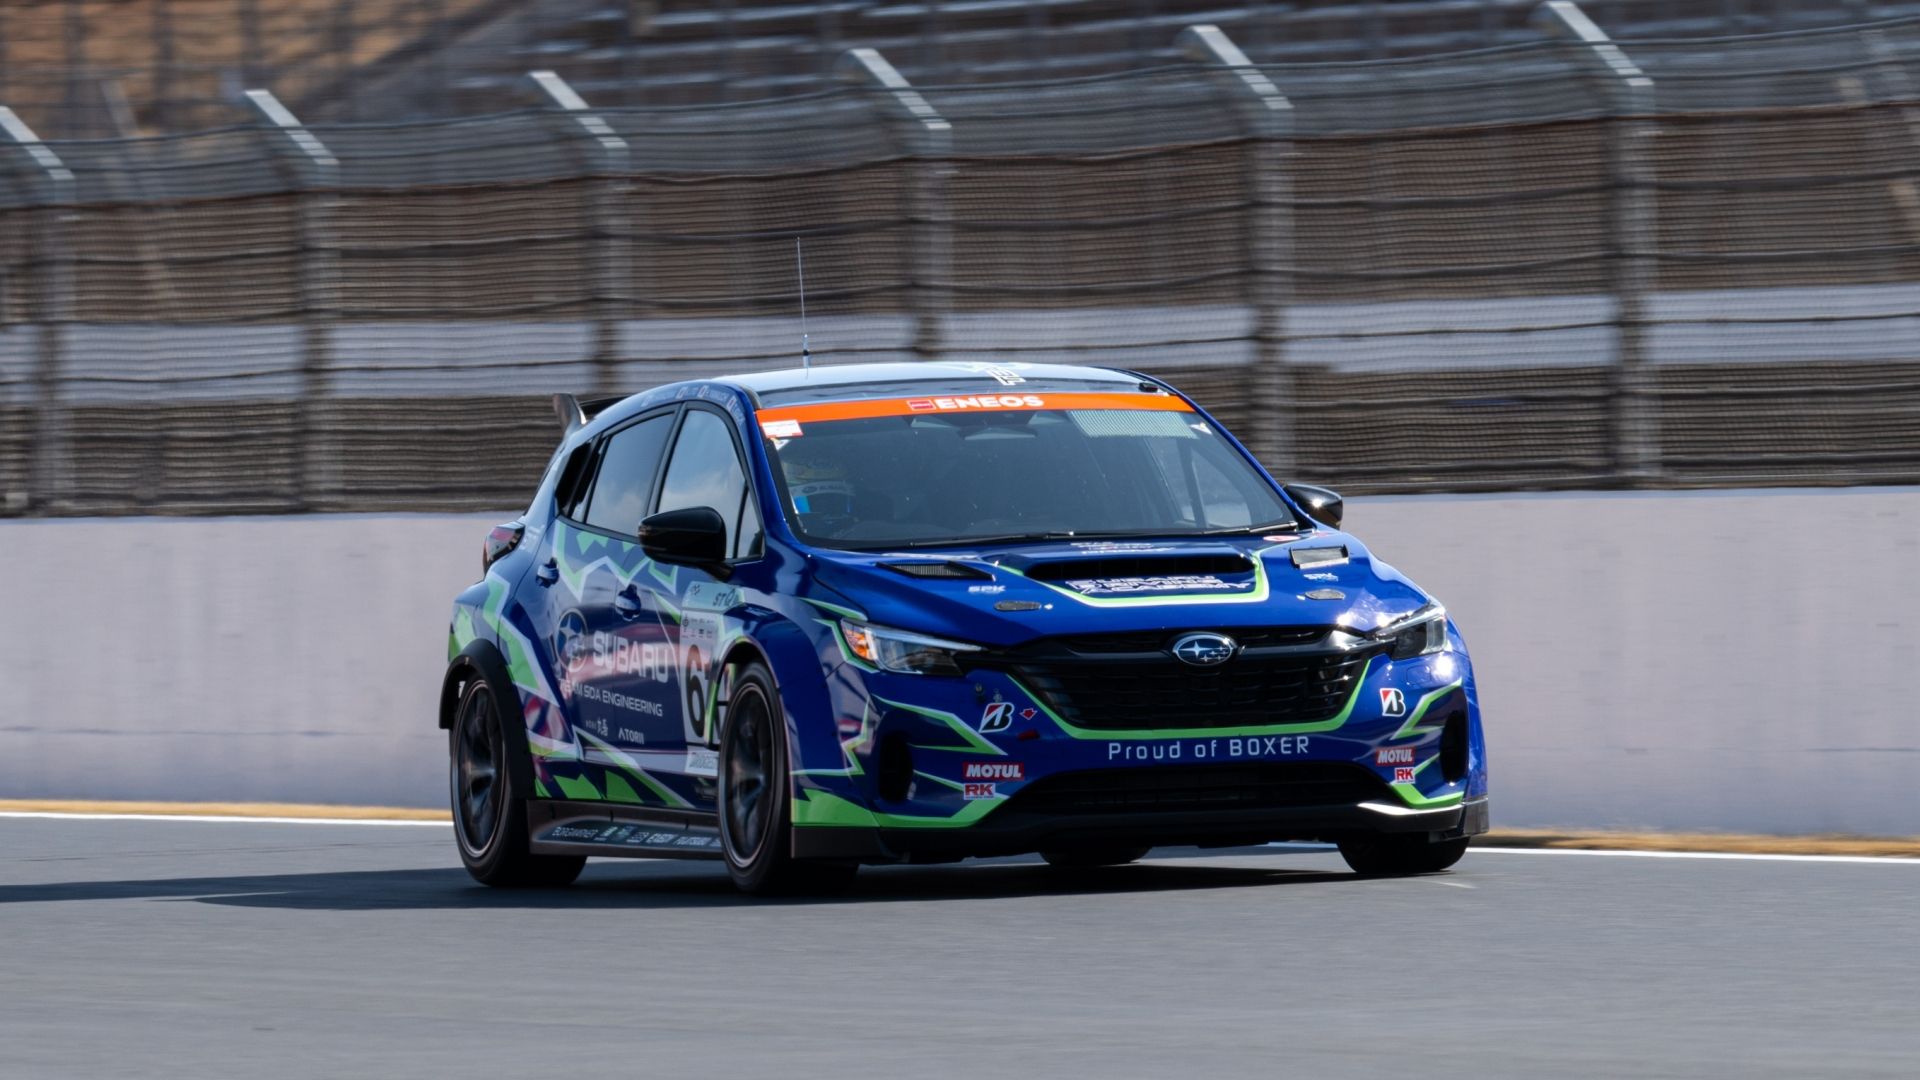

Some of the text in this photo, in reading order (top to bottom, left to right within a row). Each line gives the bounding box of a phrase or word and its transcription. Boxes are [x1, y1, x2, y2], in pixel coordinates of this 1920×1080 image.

[935, 395, 1044, 409] ENEOS
[593, 630, 669, 684] SUBARU
[584, 684, 601, 700] SDA
[602, 690, 663, 717] ENGINEERING
[1108, 736, 1310, 760] Proud of BOXER
[1377, 749, 1413, 763] MOTUL
[966, 764, 1022, 778] MOTUL
[1396, 768, 1414, 780] RK
[964, 784, 993, 796] RK
